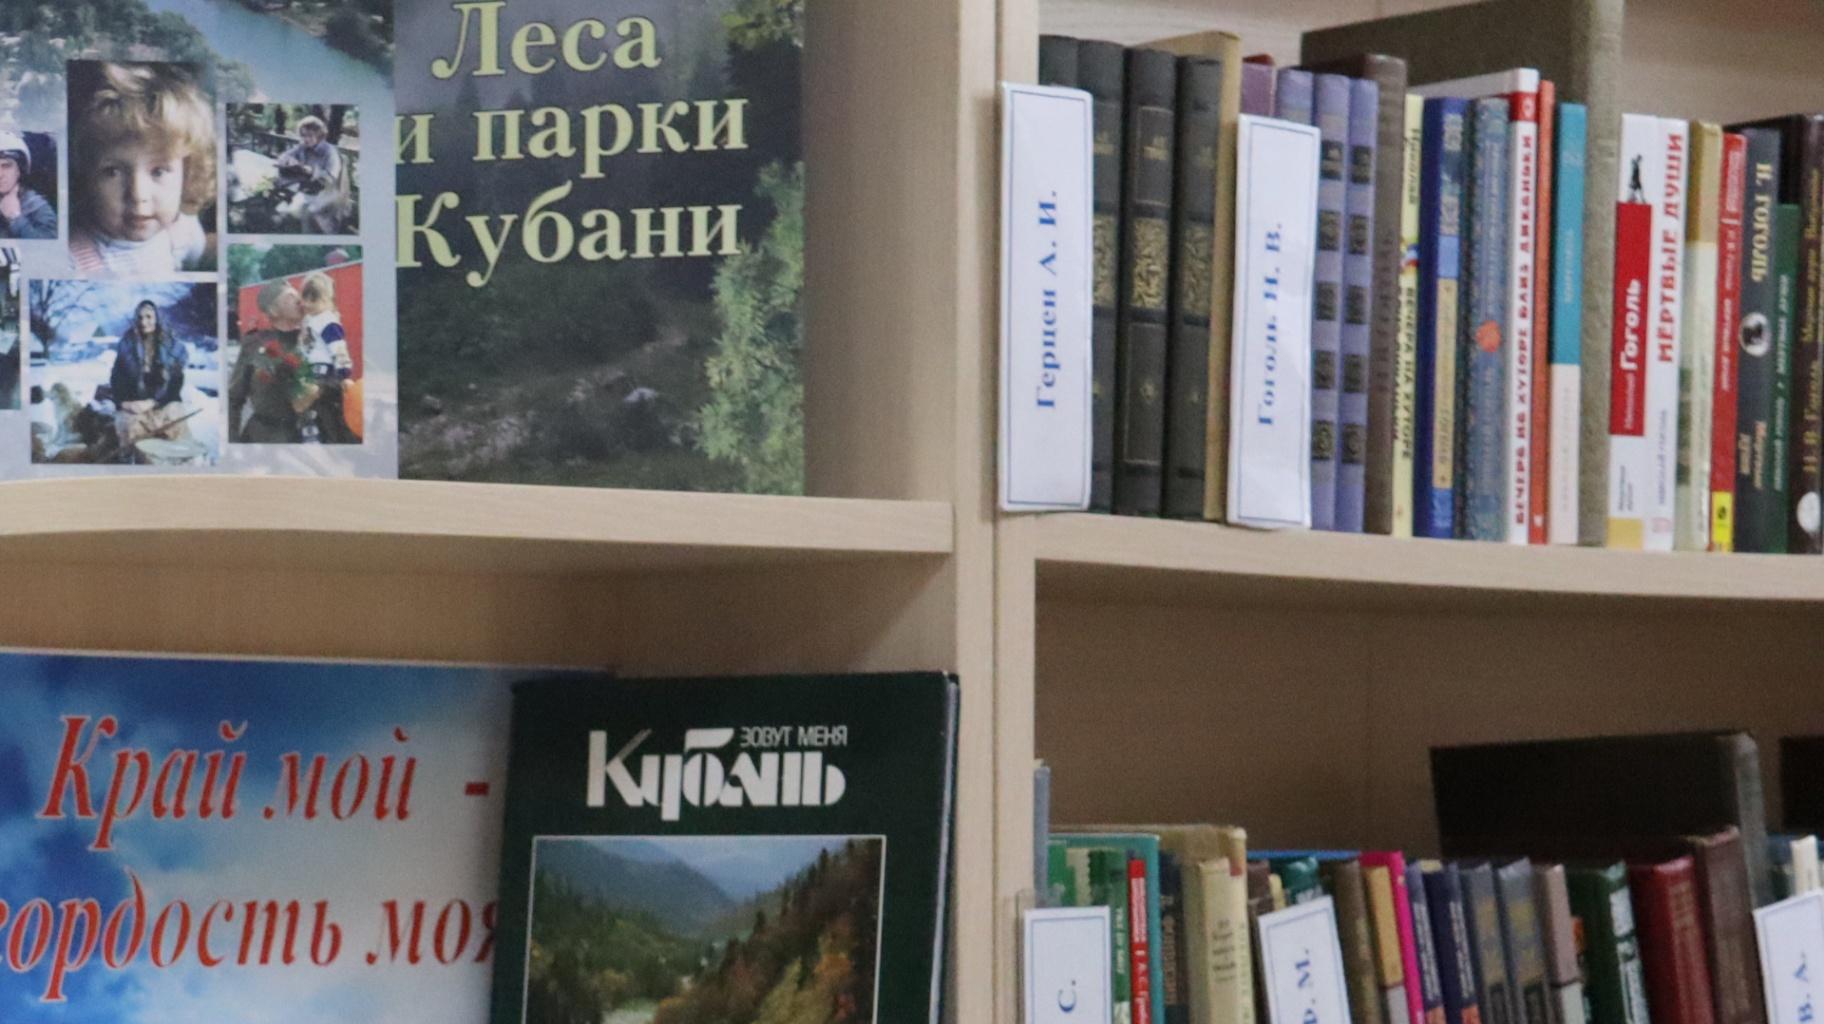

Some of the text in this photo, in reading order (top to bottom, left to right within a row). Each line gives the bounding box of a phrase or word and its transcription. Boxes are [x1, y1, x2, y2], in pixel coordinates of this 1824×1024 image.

[431, 1, 662, 80] Леса
[395, 98, 750, 179] и парки
[1663, 132, 1683, 219] ДУШИ
[395, 180, 743, 288] Кубани
[1751, 192, 1771, 283] ГОГОЛЬ
[1035, 190, 1061, 408] Герцен А. И.
[1258, 223, 1283, 426] Гоголь Н. В.
[1620, 279, 1641, 371] Гоголь
[739, 725, 848, 748] ЗОВУТ МЕНЯ
[36, 714, 249, 852] Край
[262, 727, 417, 821] мой
[1057, 979, 1077, 1015] С.
[1294, 947, 1312, 988] М.
[1793, 951, 1808, 984] А.
[1797, 994, 1813, 1024] В.
